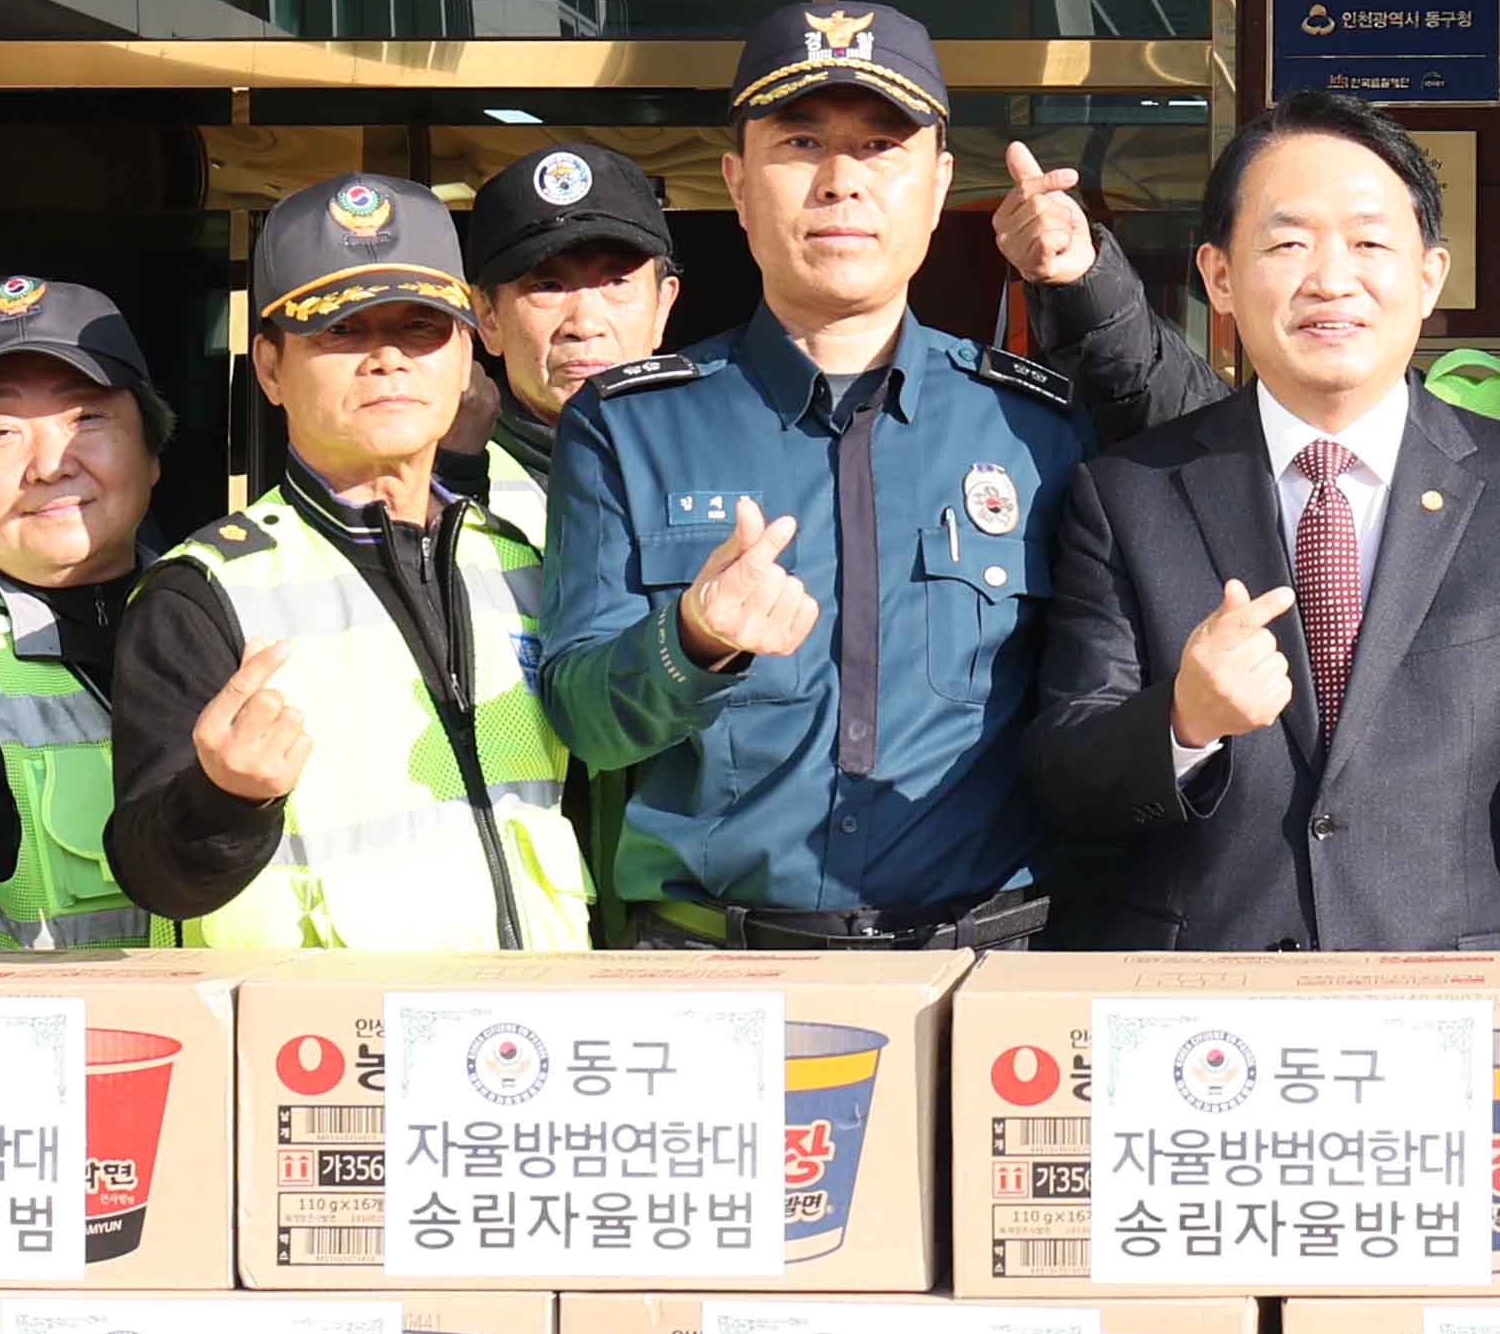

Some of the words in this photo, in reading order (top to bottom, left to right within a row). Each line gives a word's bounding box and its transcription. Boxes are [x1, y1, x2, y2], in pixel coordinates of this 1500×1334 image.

[1342, 10, 1419, 29] 인천광역시
[1425, 10, 1473, 29] 동구청
[566, 1039, 678, 1097] 동구
[1273, 1047, 1386, 1106] 동구
[405, 1120, 758, 1179] 자율방범연합대
[1110, 1129, 1468, 1188] 자율방범연합대
[408, 1191, 753, 1251] 송림자율방범
[1113, 1199, 1460, 1259] 송림자율방범
